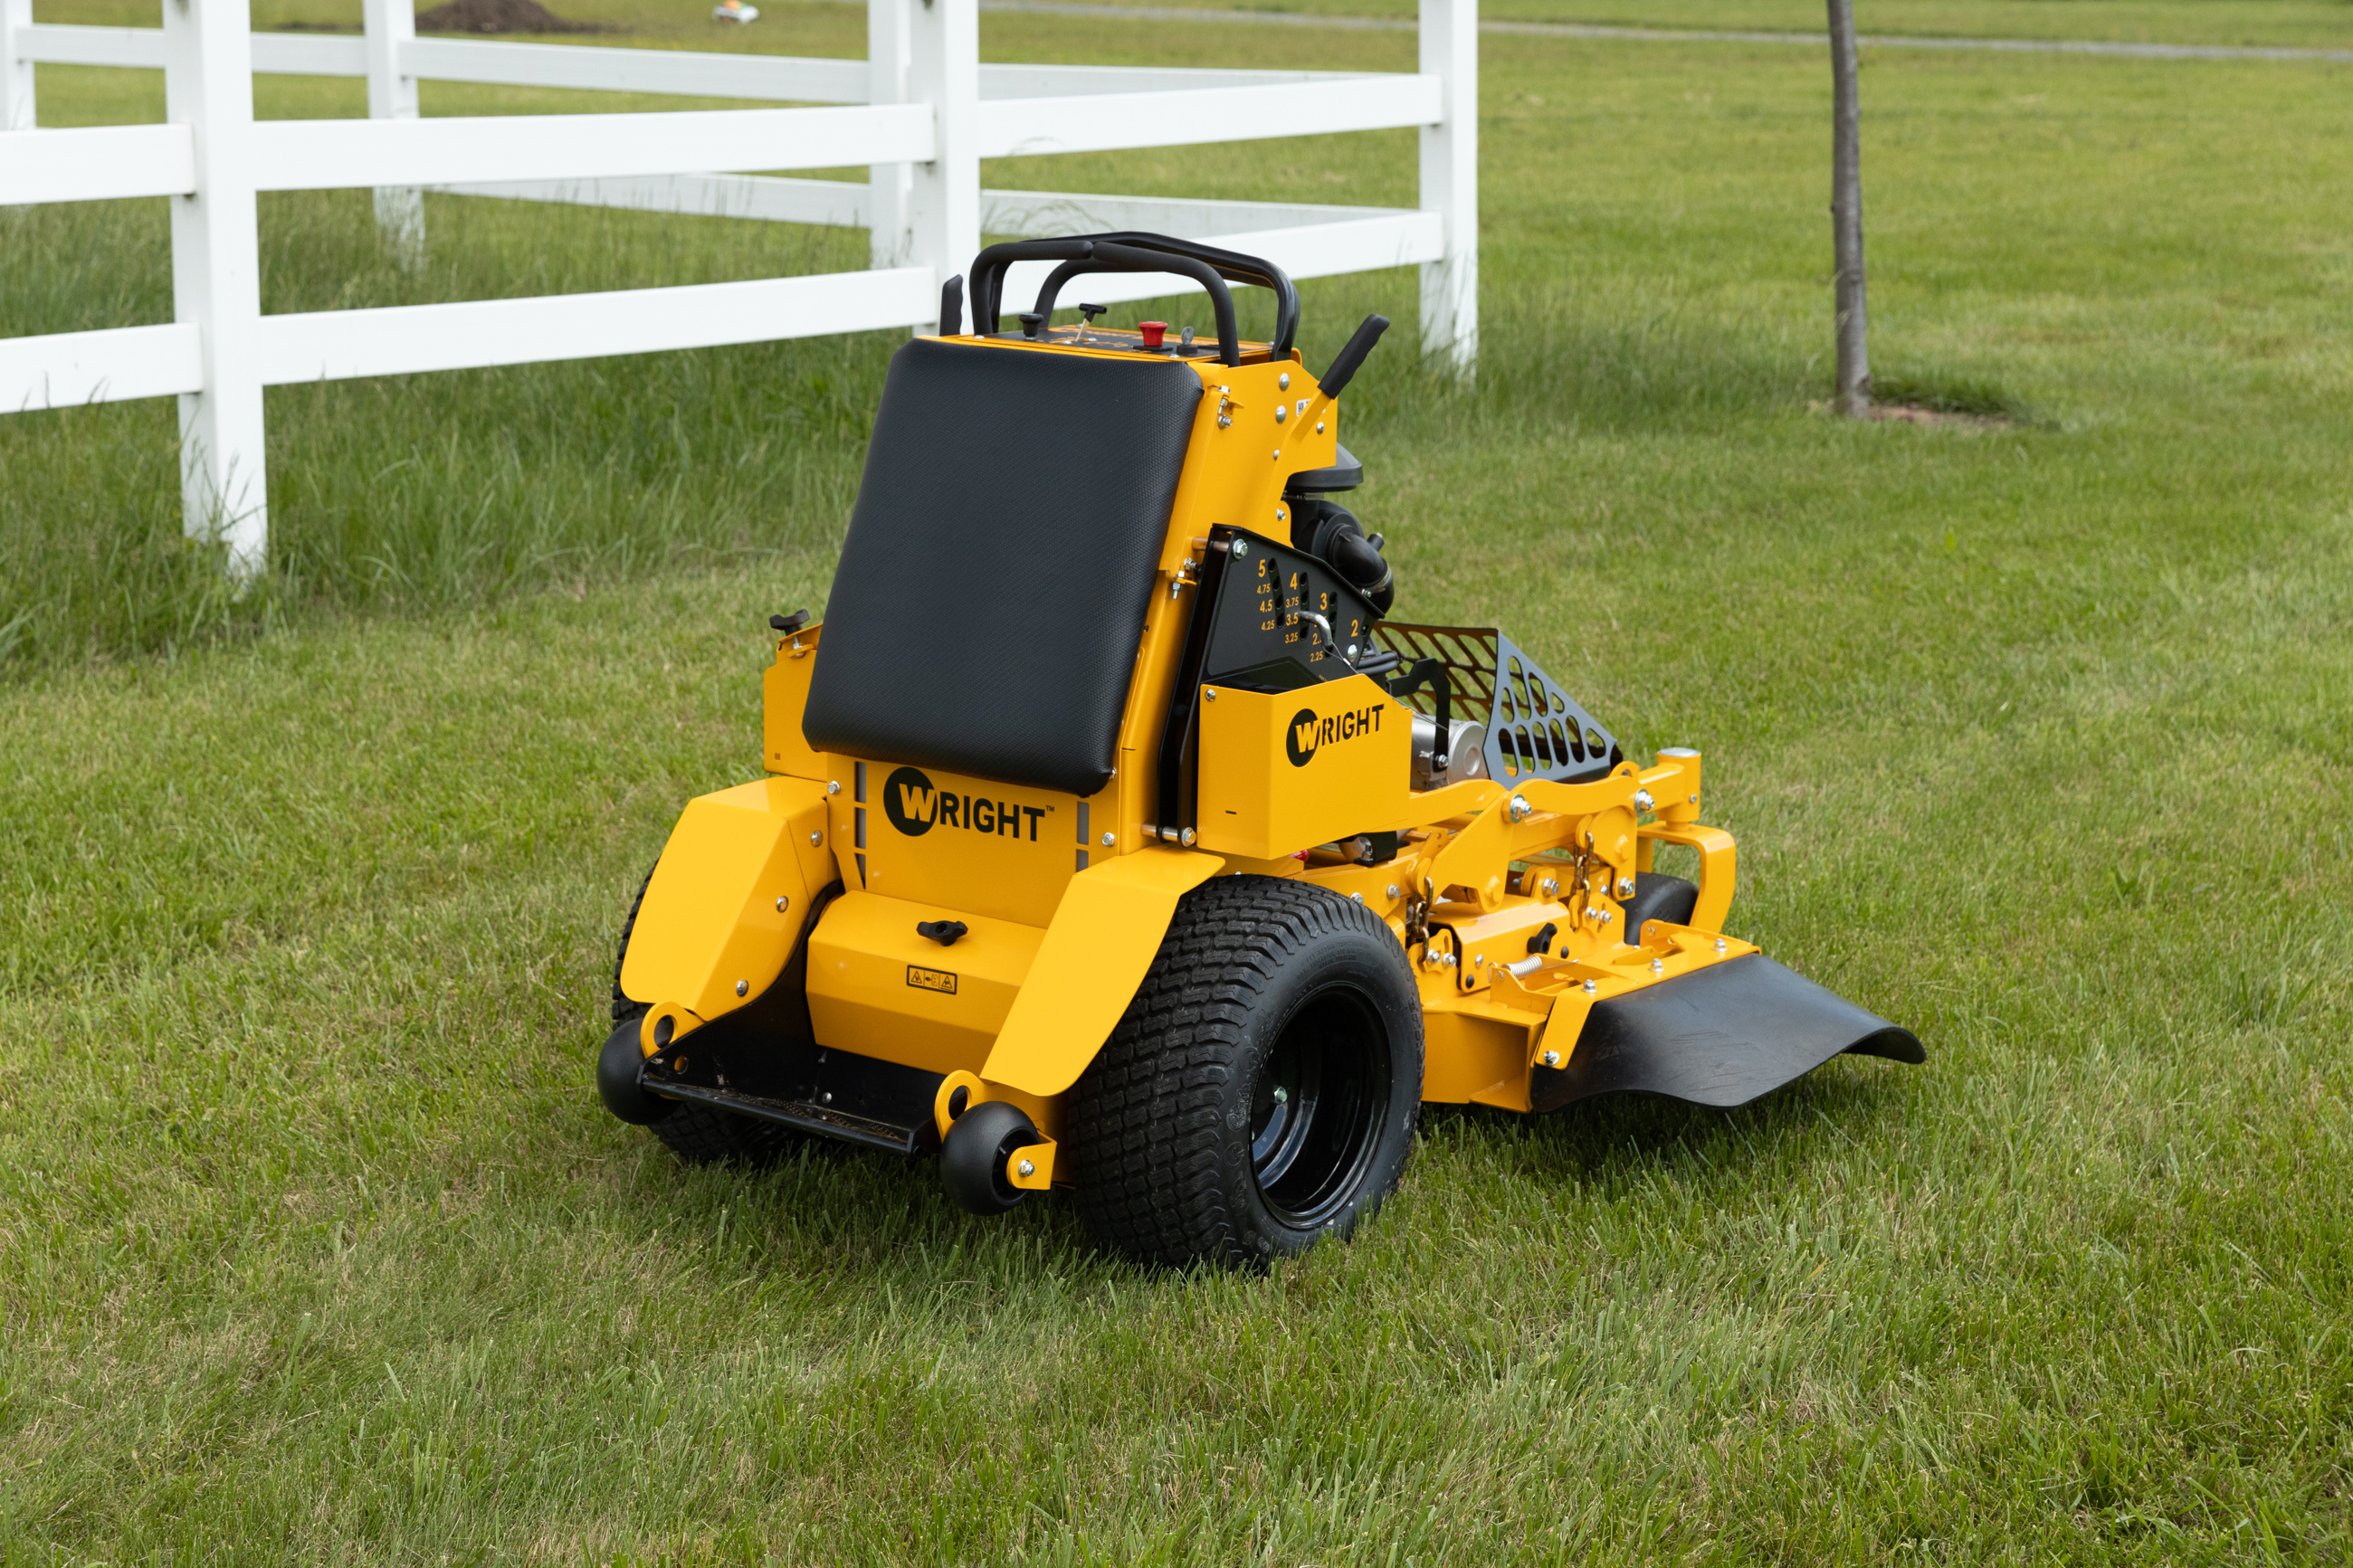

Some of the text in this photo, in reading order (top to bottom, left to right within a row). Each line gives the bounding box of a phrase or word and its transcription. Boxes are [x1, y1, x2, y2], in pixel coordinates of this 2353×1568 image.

[1258, 559, 1265, 577] 5
[1290, 573, 1297, 590] 4
[1257, 584, 1271, 594] 4.75
[1260, 599, 1272, 613] 4.5
[1286, 596, 1299, 608] 3.75
[1320, 593, 1327, 611] 3
[1262, 620, 1274, 631] 4.25
[1286, 613, 1298, 626] 3.5
[1351, 619, 1358, 637] 2
[1285, 632, 1298, 643] 3.25
[1310, 651, 1323, 662] 2.25
[1295, 704, 1385, 754] WRIGHT
